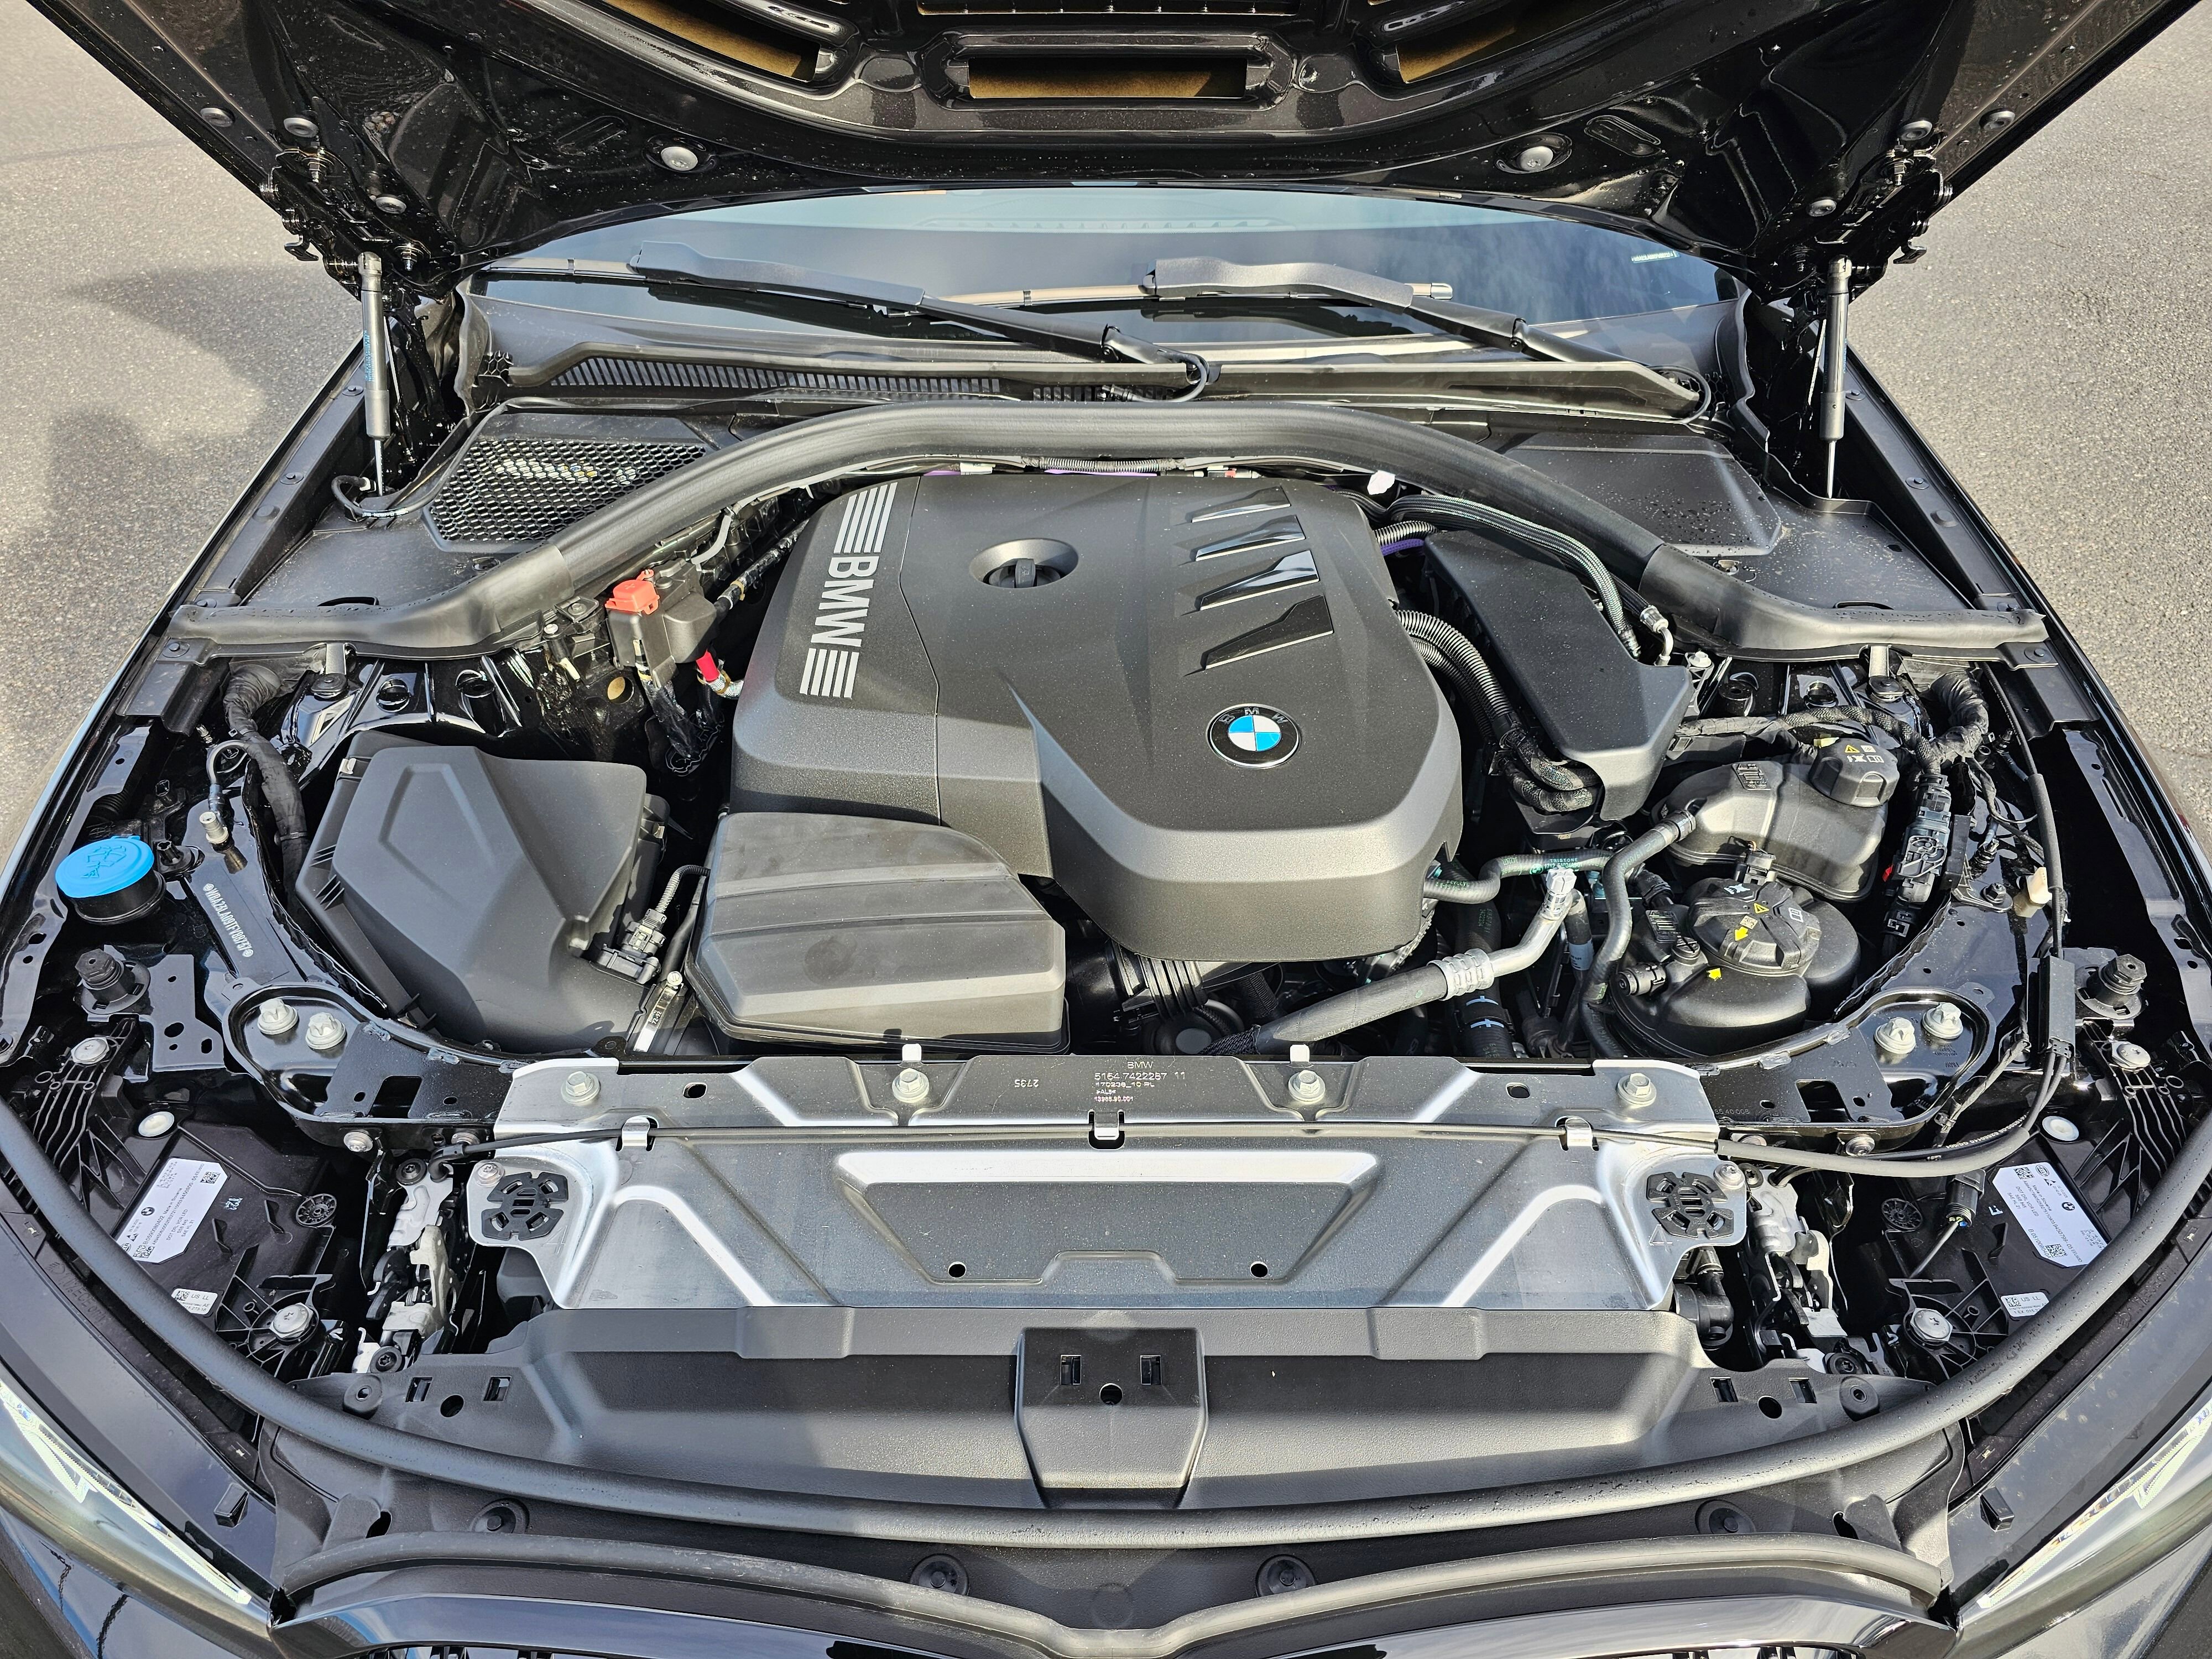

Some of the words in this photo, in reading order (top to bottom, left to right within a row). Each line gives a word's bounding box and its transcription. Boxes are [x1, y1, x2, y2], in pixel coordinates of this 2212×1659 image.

[811, 556, 878, 647] BMW
[1218, 707, 1288, 724] BMW
[652, 1011, 662, 1024] 72-92
[1015, 1079, 1039, 1088] 2735
[72, 1284, 96, 1309] ECE
